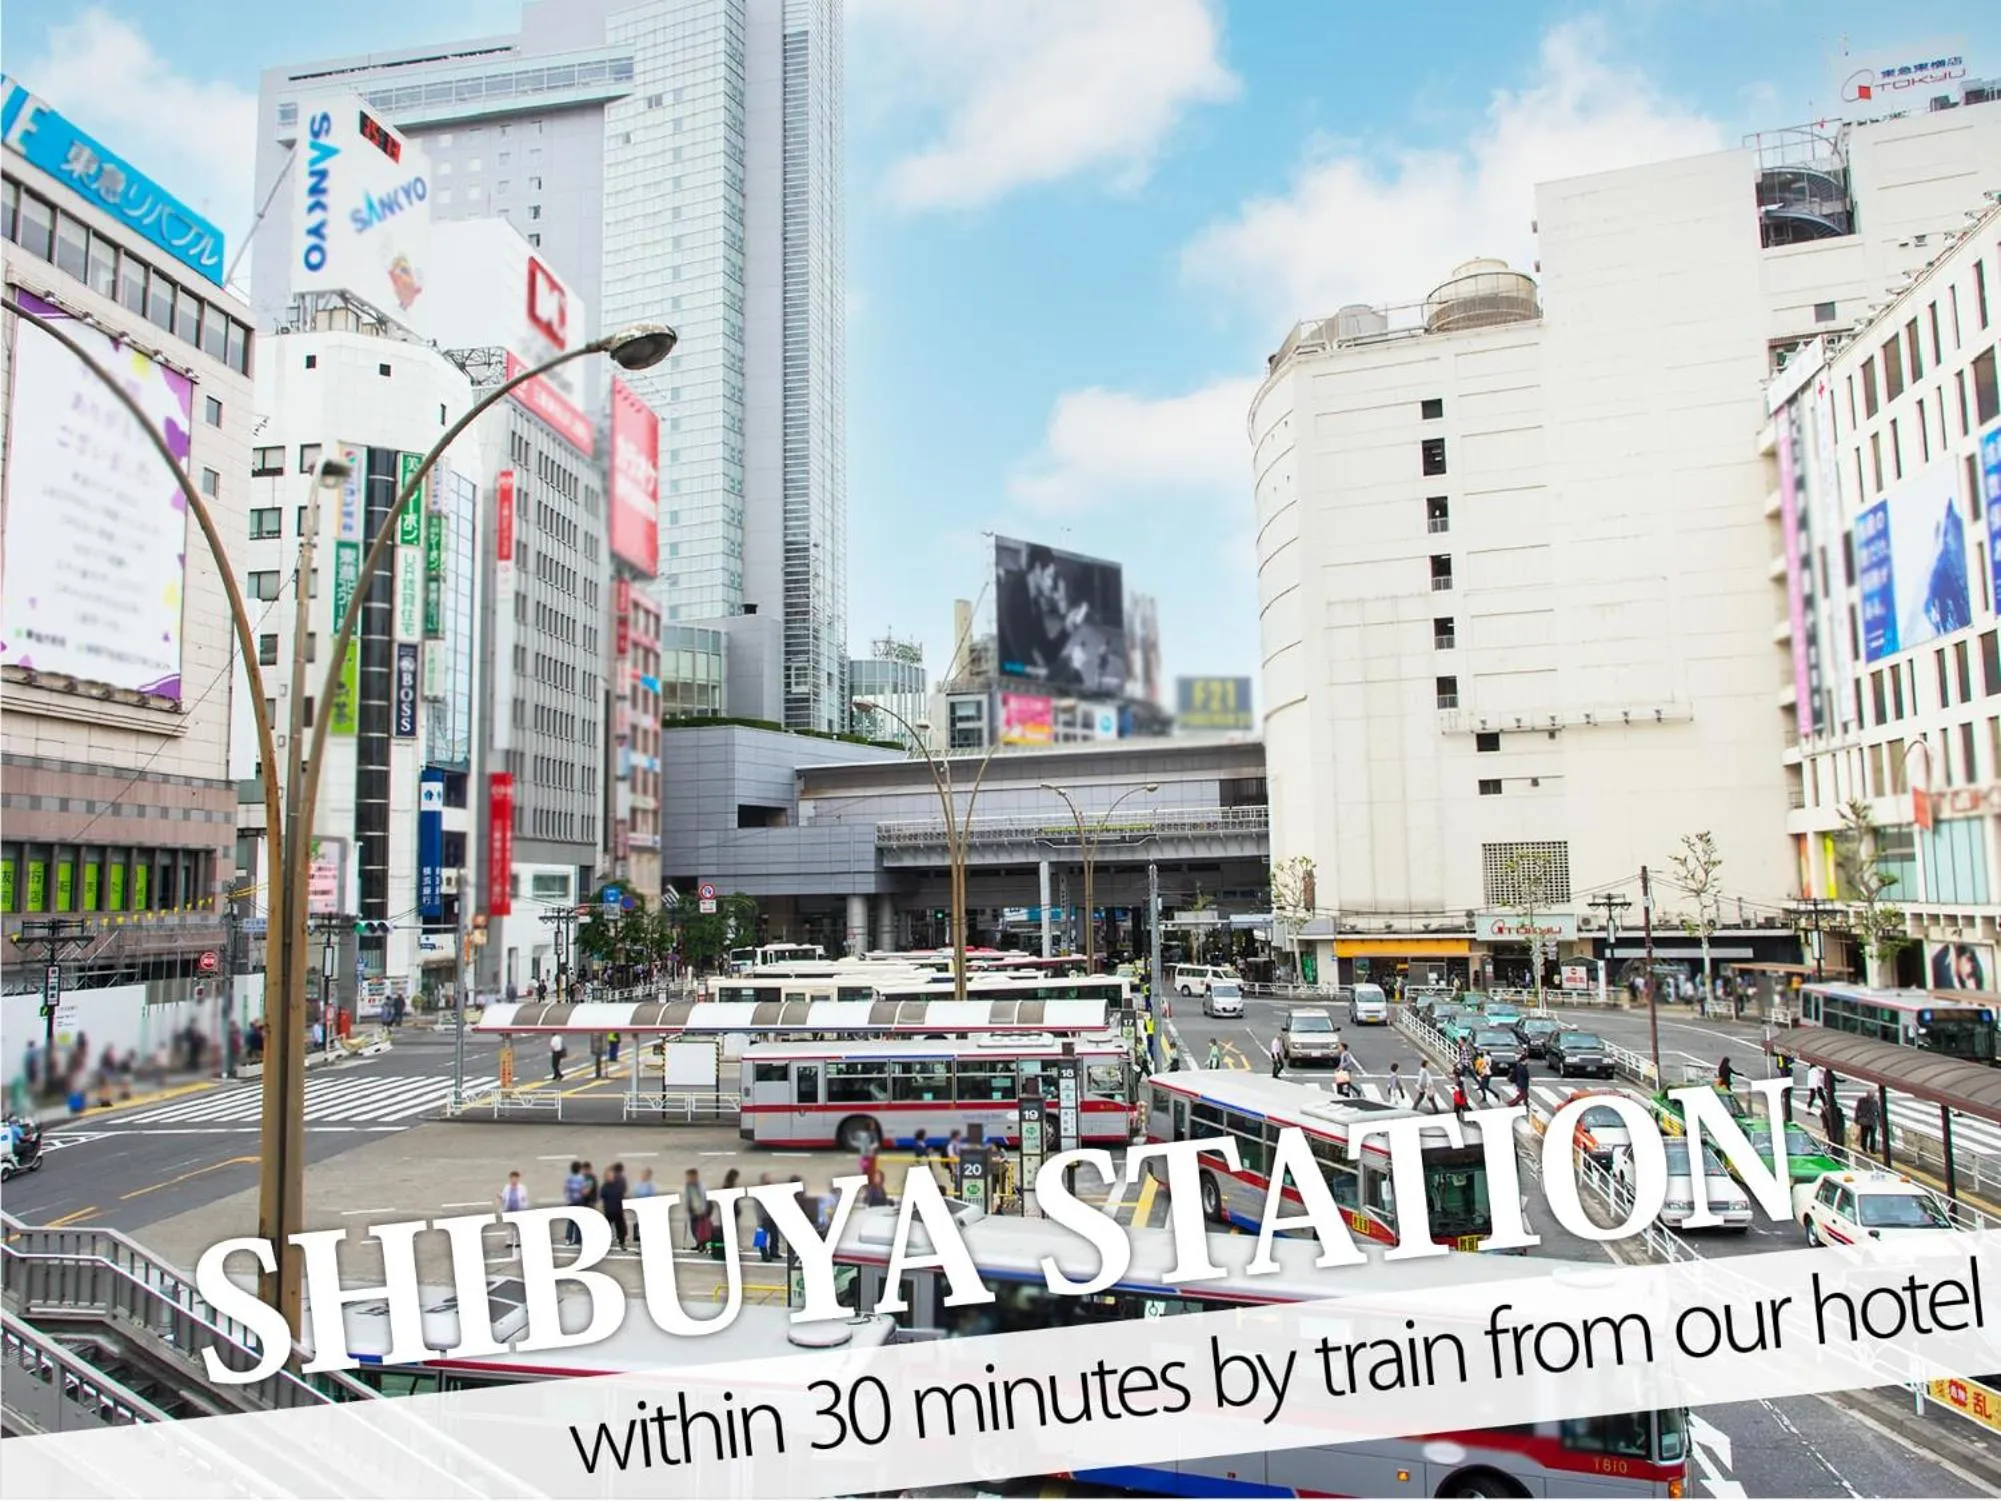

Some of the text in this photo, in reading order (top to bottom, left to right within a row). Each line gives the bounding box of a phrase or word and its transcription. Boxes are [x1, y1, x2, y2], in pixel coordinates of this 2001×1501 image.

[1874, 68, 1966, 91] TOKYU
[303, 111, 341, 272] SANKYO
[349, 176, 428, 234] SANKYO
[1061, 1068, 1074, 1078] 18
[1023, 1110, 1038, 1120] 19
[963, 1163, 982, 1176] 20
